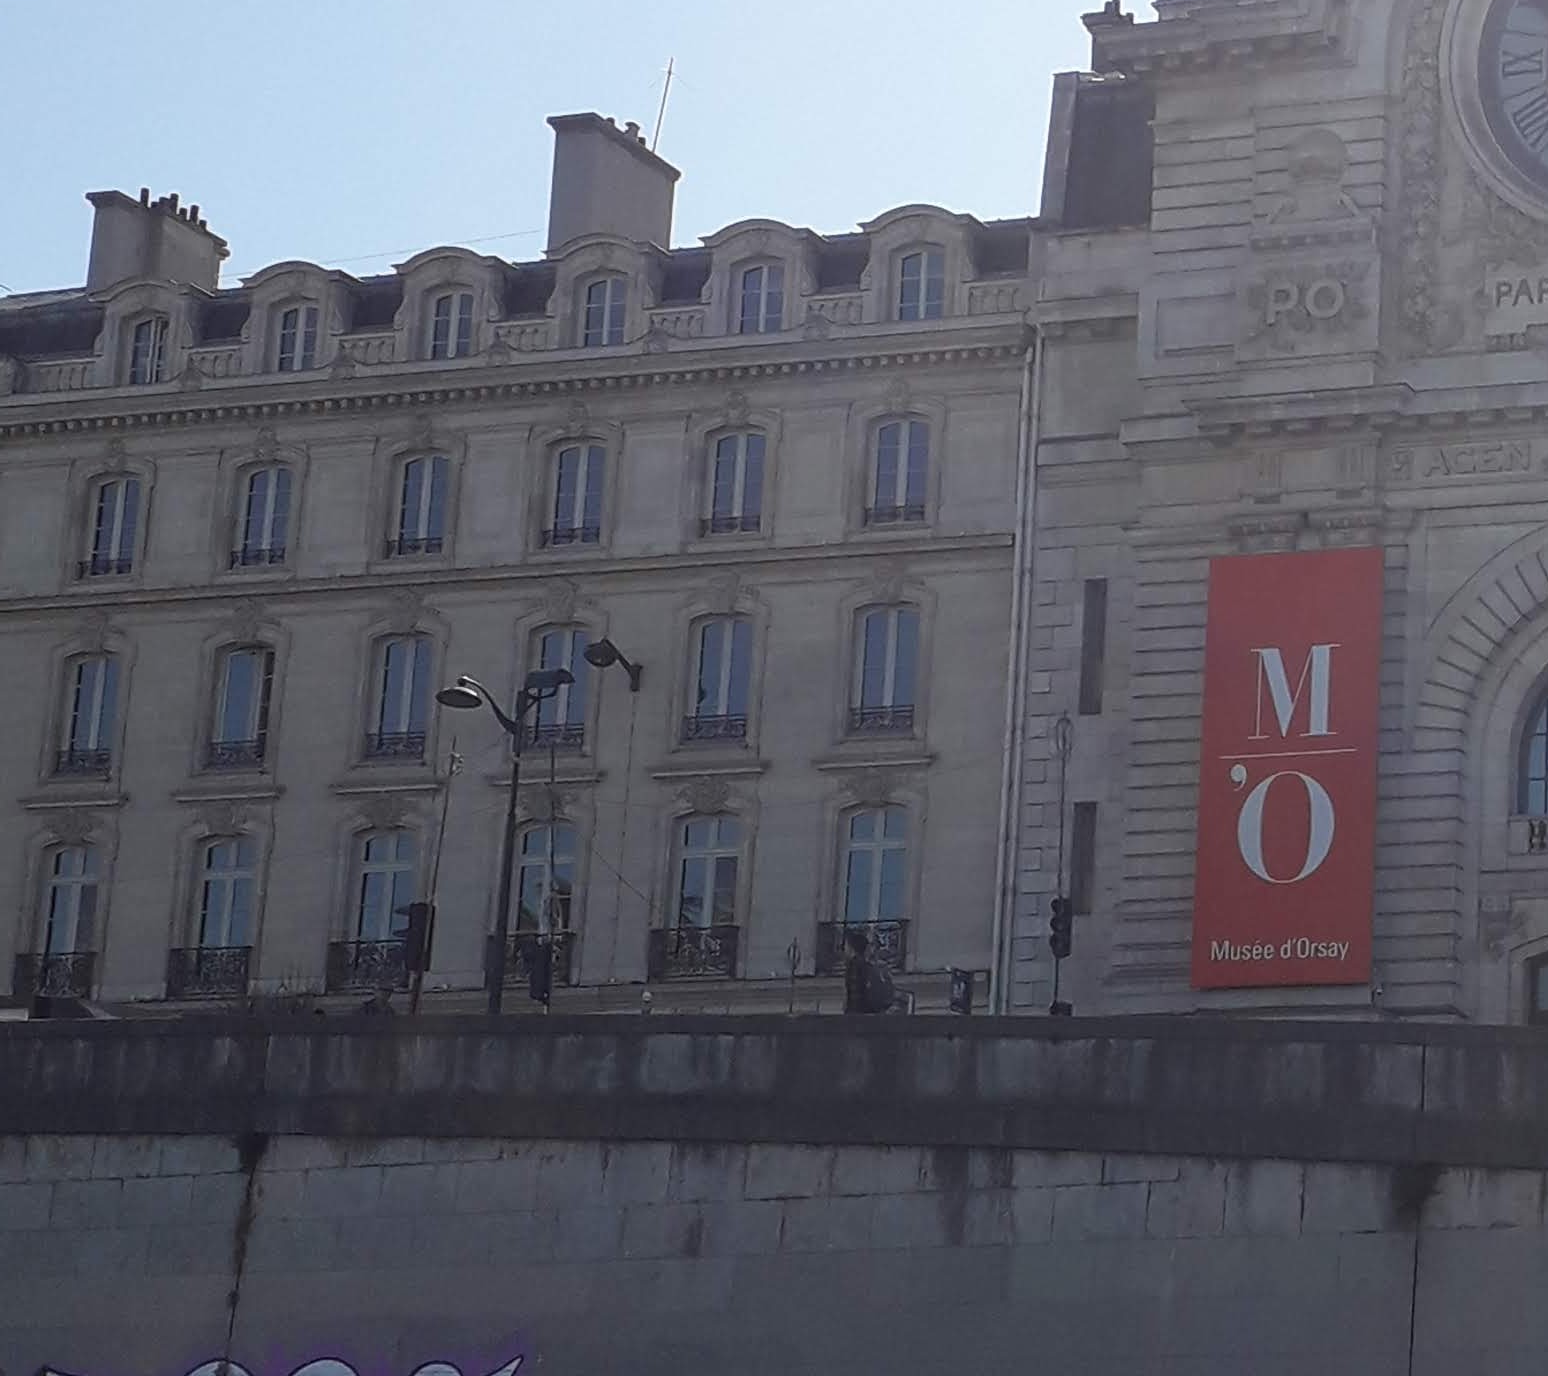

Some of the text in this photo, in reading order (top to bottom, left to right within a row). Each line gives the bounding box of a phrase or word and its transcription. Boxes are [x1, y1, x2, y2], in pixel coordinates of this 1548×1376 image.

[1265, 279, 1344, 324] PO
[1248, 643, 1342, 740] M
[1210, 936, 1350, 961] Musée d'Orsay
